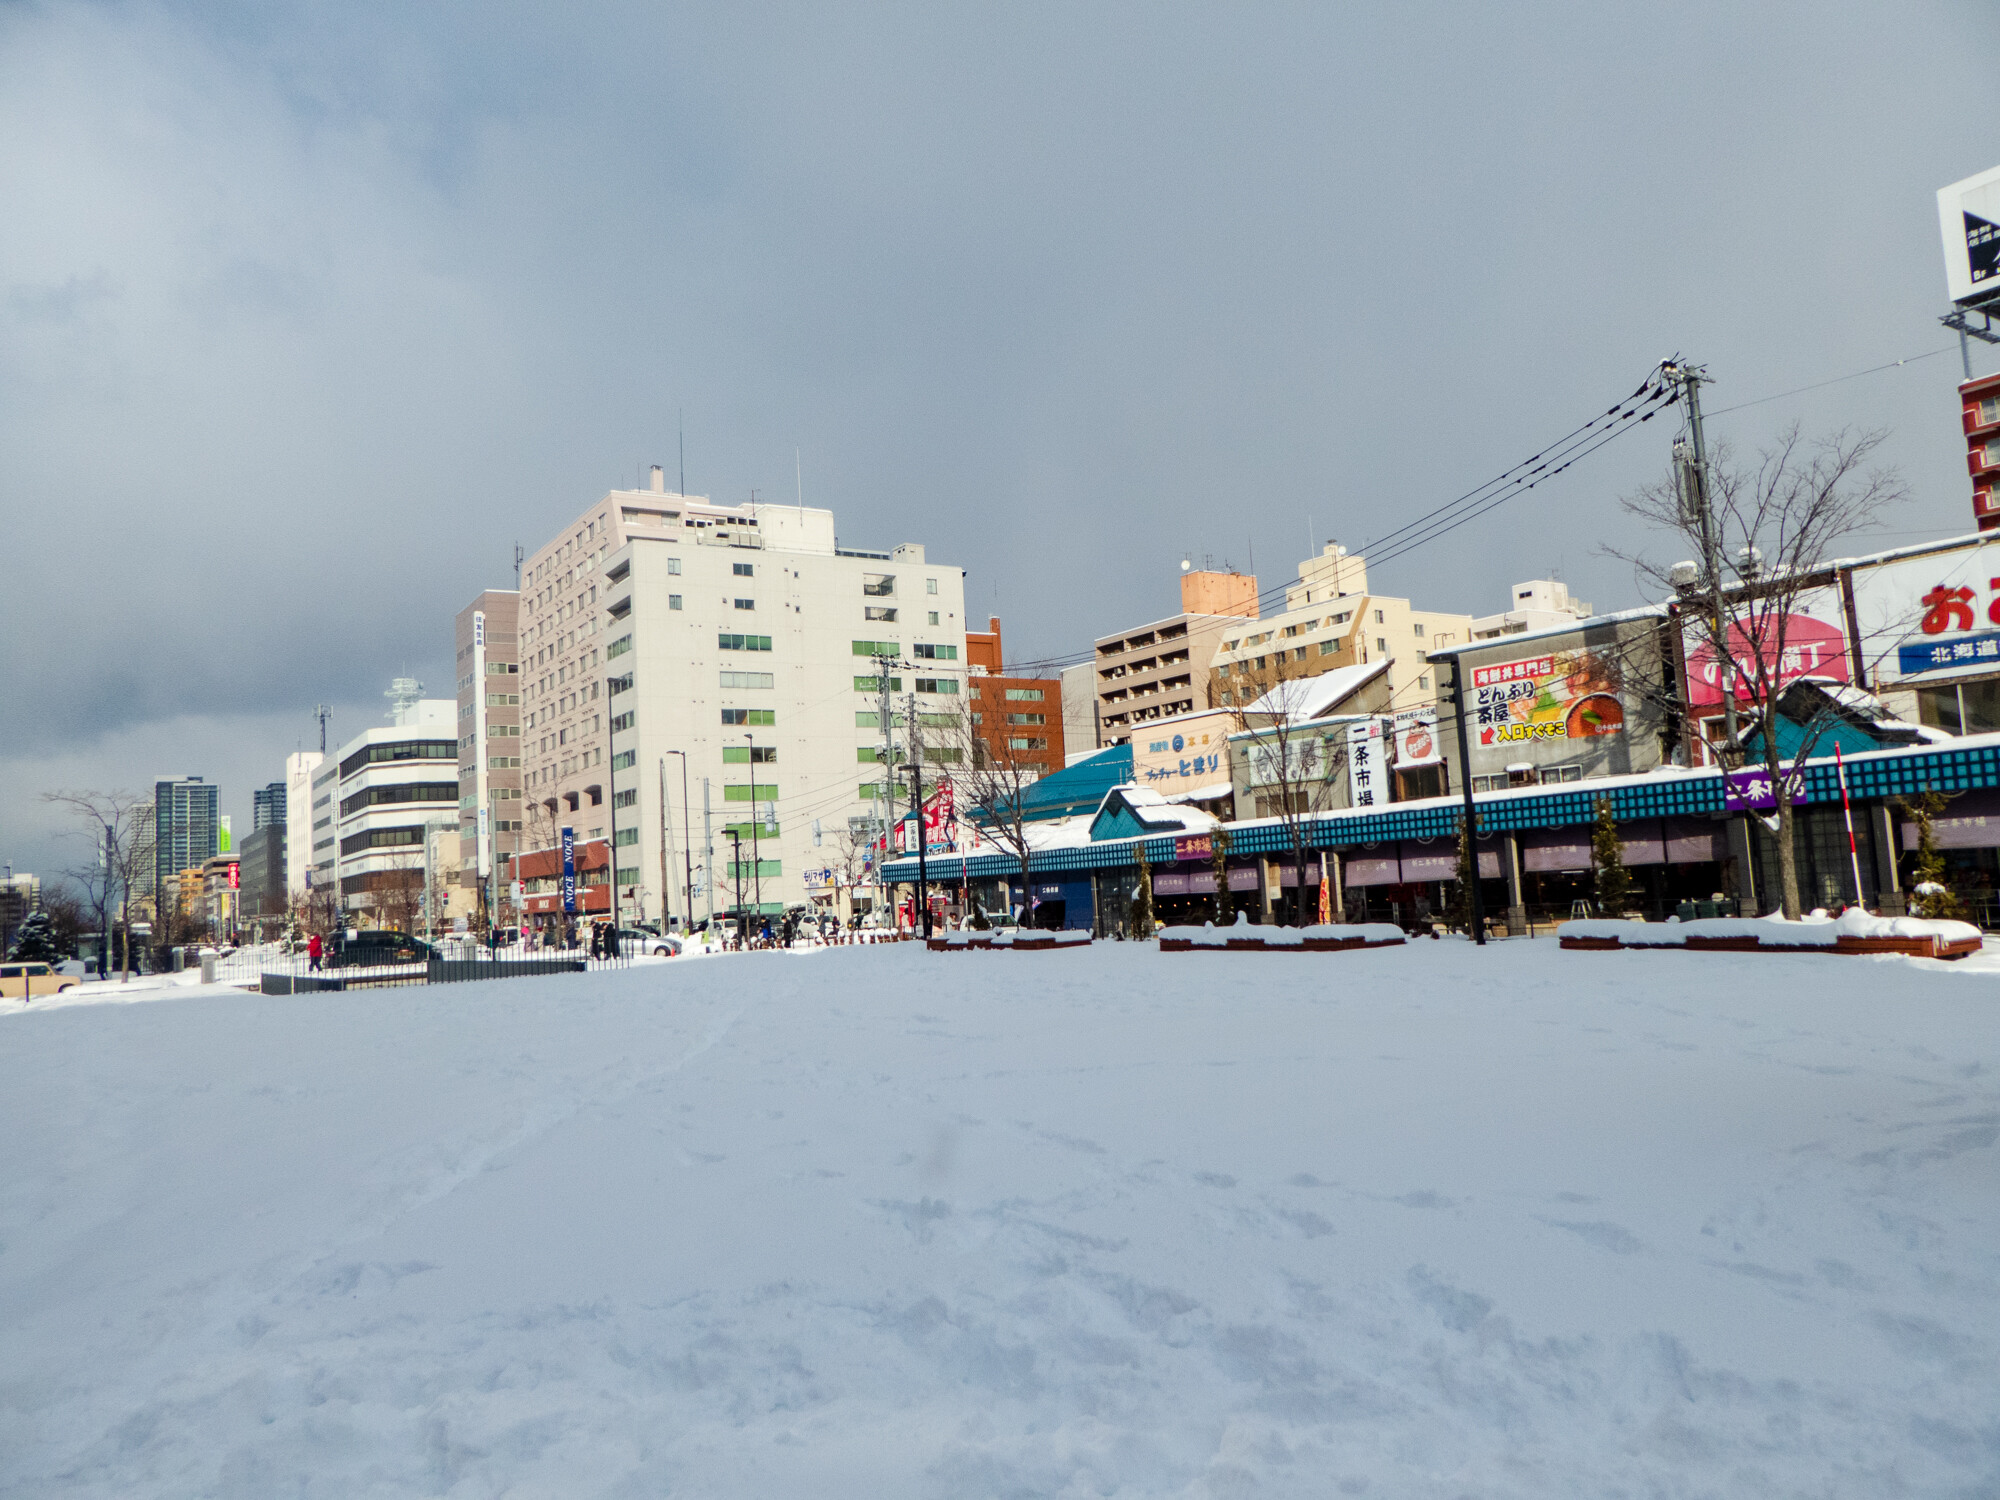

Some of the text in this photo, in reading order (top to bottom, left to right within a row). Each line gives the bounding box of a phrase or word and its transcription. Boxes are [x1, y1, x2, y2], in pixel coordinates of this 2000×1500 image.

[1920, 577, 2000, 636] お
[1930, 639, 1999, 663] 北海道
[1476, 659, 1552, 684] 海鮮丼専門店
[1477, 680, 1535, 705] どんぶり
[1476, 702, 1509, 725] 茶屋
[1496, 721, 1566, 743] 入口すぐそこ
[1353, 726, 1374, 807] 二条市場
[564, 835, 574, 864] NOCE
[1176, 837, 1212, 854] 二条市場
[803, 871, 824, 882] モリマサ
[824, 869, 832, 884] P
[565, 875, 575, 905] NOCE
